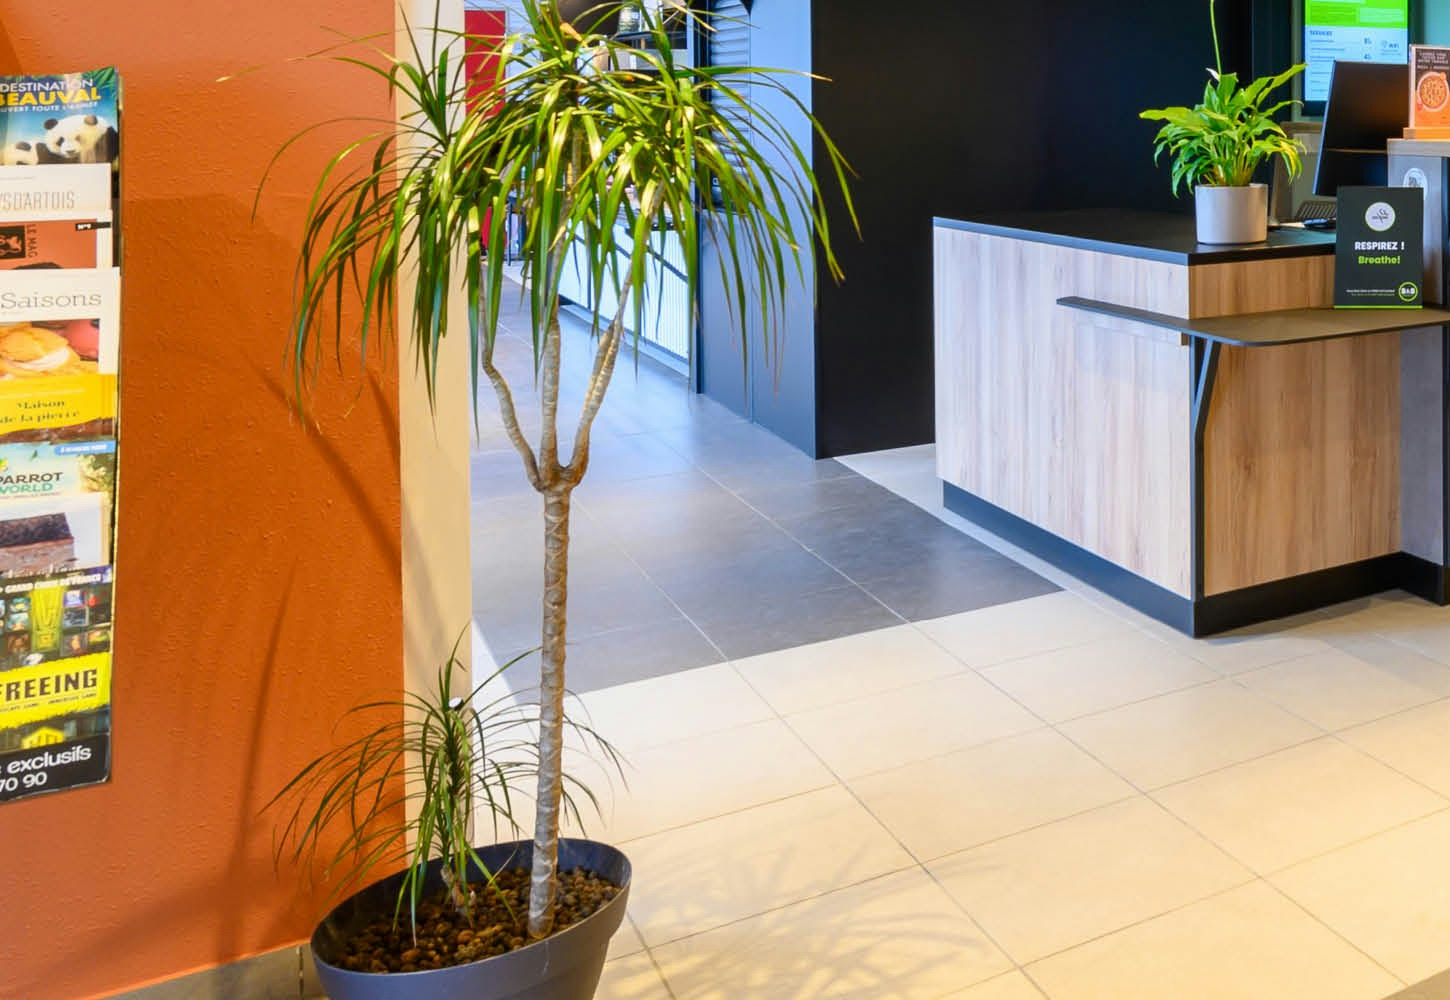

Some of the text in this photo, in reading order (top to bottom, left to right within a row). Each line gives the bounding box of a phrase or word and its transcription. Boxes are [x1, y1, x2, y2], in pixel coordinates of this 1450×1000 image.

[0, 79, 93, 92] DESTINATION
[1354, 241, 1398, 250] RESPIREZ
[1358, 255, 1400, 264] Breathe!
[0, 291, 102, 309] Saisons
[0, 669, 97, 702] REEING
[7, 745, 92, 774] exclusifs
[22, 771, 48, 788] 90
